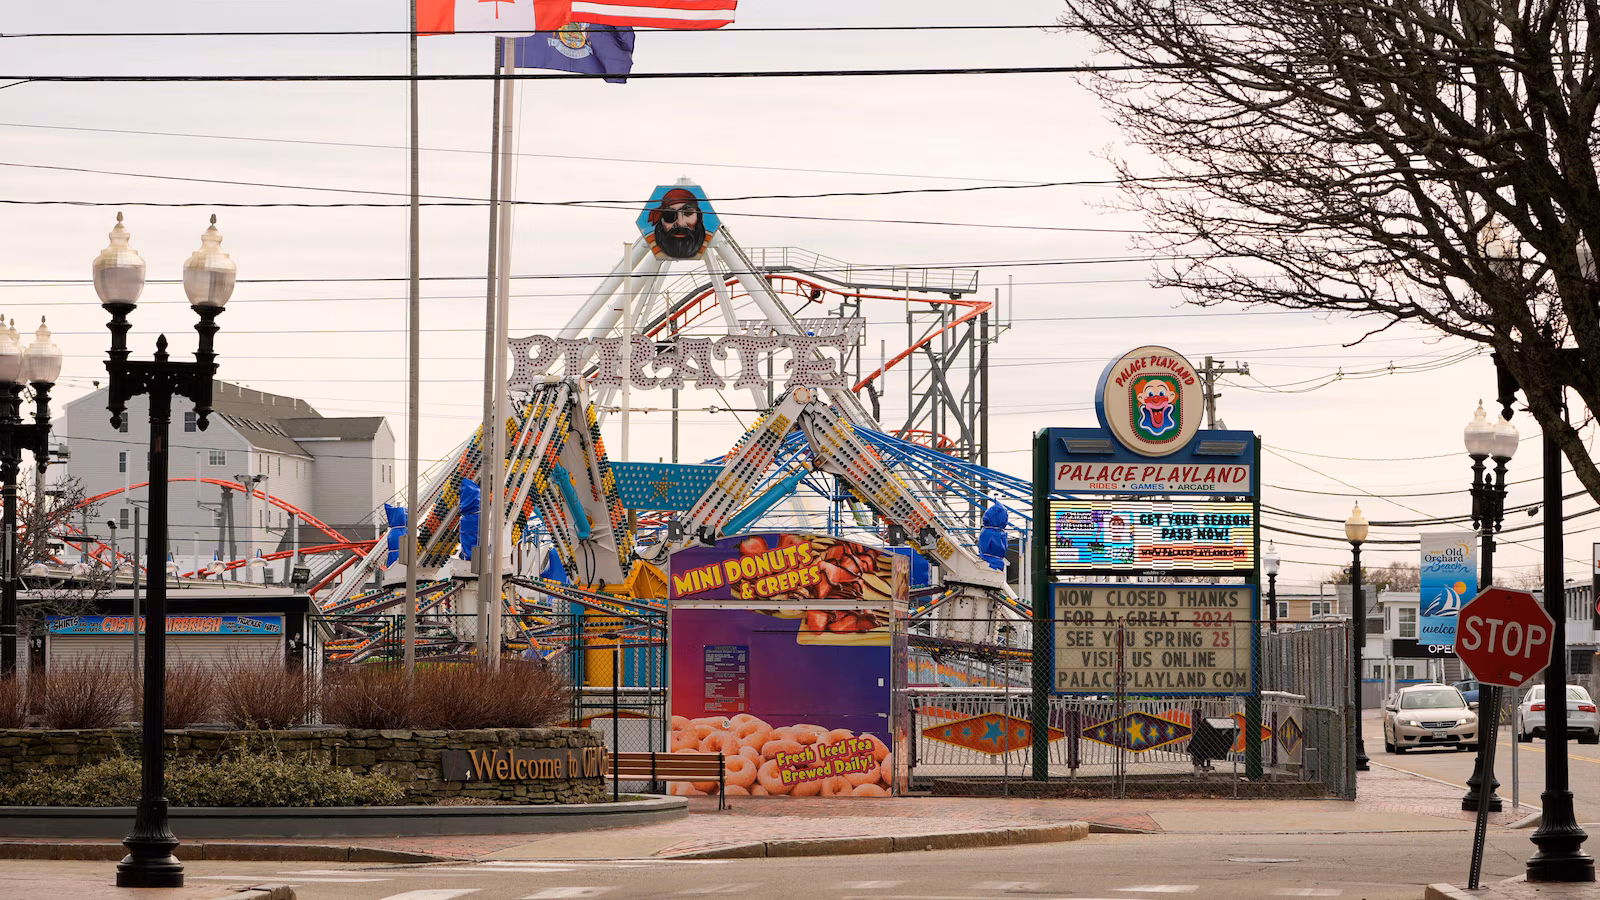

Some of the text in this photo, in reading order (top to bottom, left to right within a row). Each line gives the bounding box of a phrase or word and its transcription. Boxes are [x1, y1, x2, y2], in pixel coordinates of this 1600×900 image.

[507, 334, 849, 391] PIRATE
[1115, 355, 1195, 388] PALACE PLAYLAND
[1057, 464, 1247, 484] PALACE PLAYLAND
[1140, 514, 1250, 526] GET YOUR SEASON
[1161, 528, 1229, 542] PASS NOW!
[1424, 554, 1464, 562] Orchard
[1445, 547, 1462, 556] Old
[673, 542, 812, 596] MINI DONUTS
[1424, 559, 1469, 572] Beach
[741, 566, 821, 600] & CREPES
[1058, 590, 1239, 607] NOW CLOSED THANKS
[237, 617, 263, 629] TRUCKER
[1063, 610, 1233, 627] FOR A GREAT 2024
[1422, 623, 1456, 634] welco
[1461, 615, 1547, 659] STOP
[1066, 631, 1230, 647] SEE YOU SPRING 25
[1132, 651, 1152, 667] US
[1161, 651, 1216, 667] ONLINE
[776, 738, 873, 767] Fresh Iced Tea
[468, 748, 562, 780] Welcome
[567, 750, 578, 778] to
[781, 754, 876, 784] Brewed Daily!
